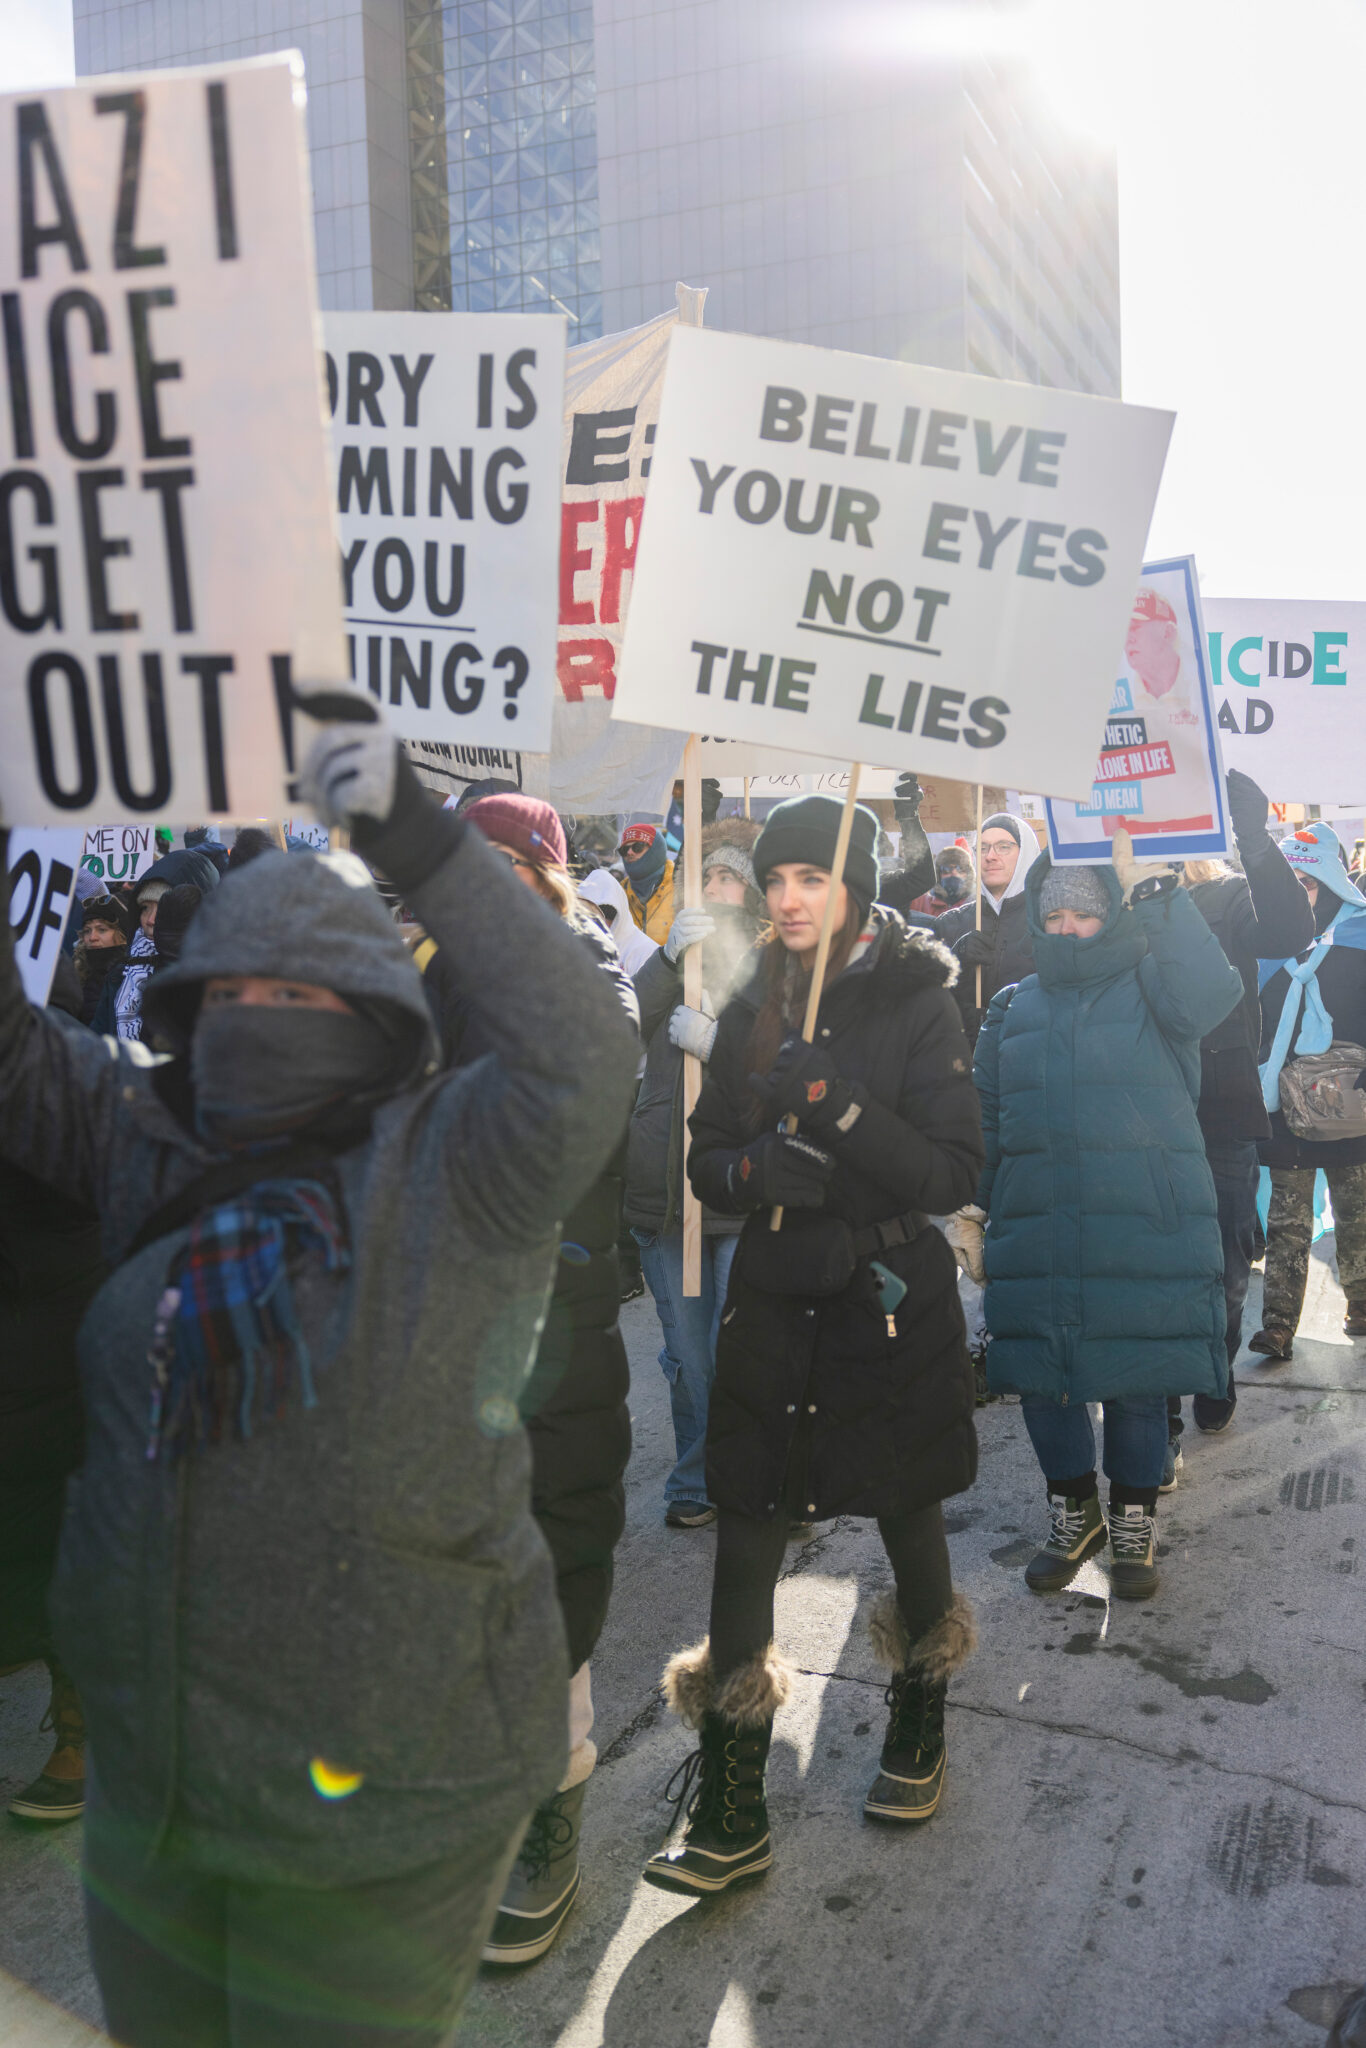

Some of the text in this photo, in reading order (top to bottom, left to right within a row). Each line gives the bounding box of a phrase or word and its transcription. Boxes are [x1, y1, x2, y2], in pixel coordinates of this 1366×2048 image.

[0, 286, 193, 461] ICE
[476, 348, 537, 430] IS
[759, 384, 1068, 489] BELIEVE
[0, 467, 197, 634] GET
[688, 457, 1110, 588] YOUR EYES
[801, 567, 952, 644] NOT
[690, 639, 1012, 750] THE LIES
[1206, 631, 1348, 687] ICIDE
[1103, 787, 1139, 810] MEAN
[1127, 751, 1144, 775] IN
[1143, 747, 1171, 773] LIFE
[121, 827, 150, 853] ON
